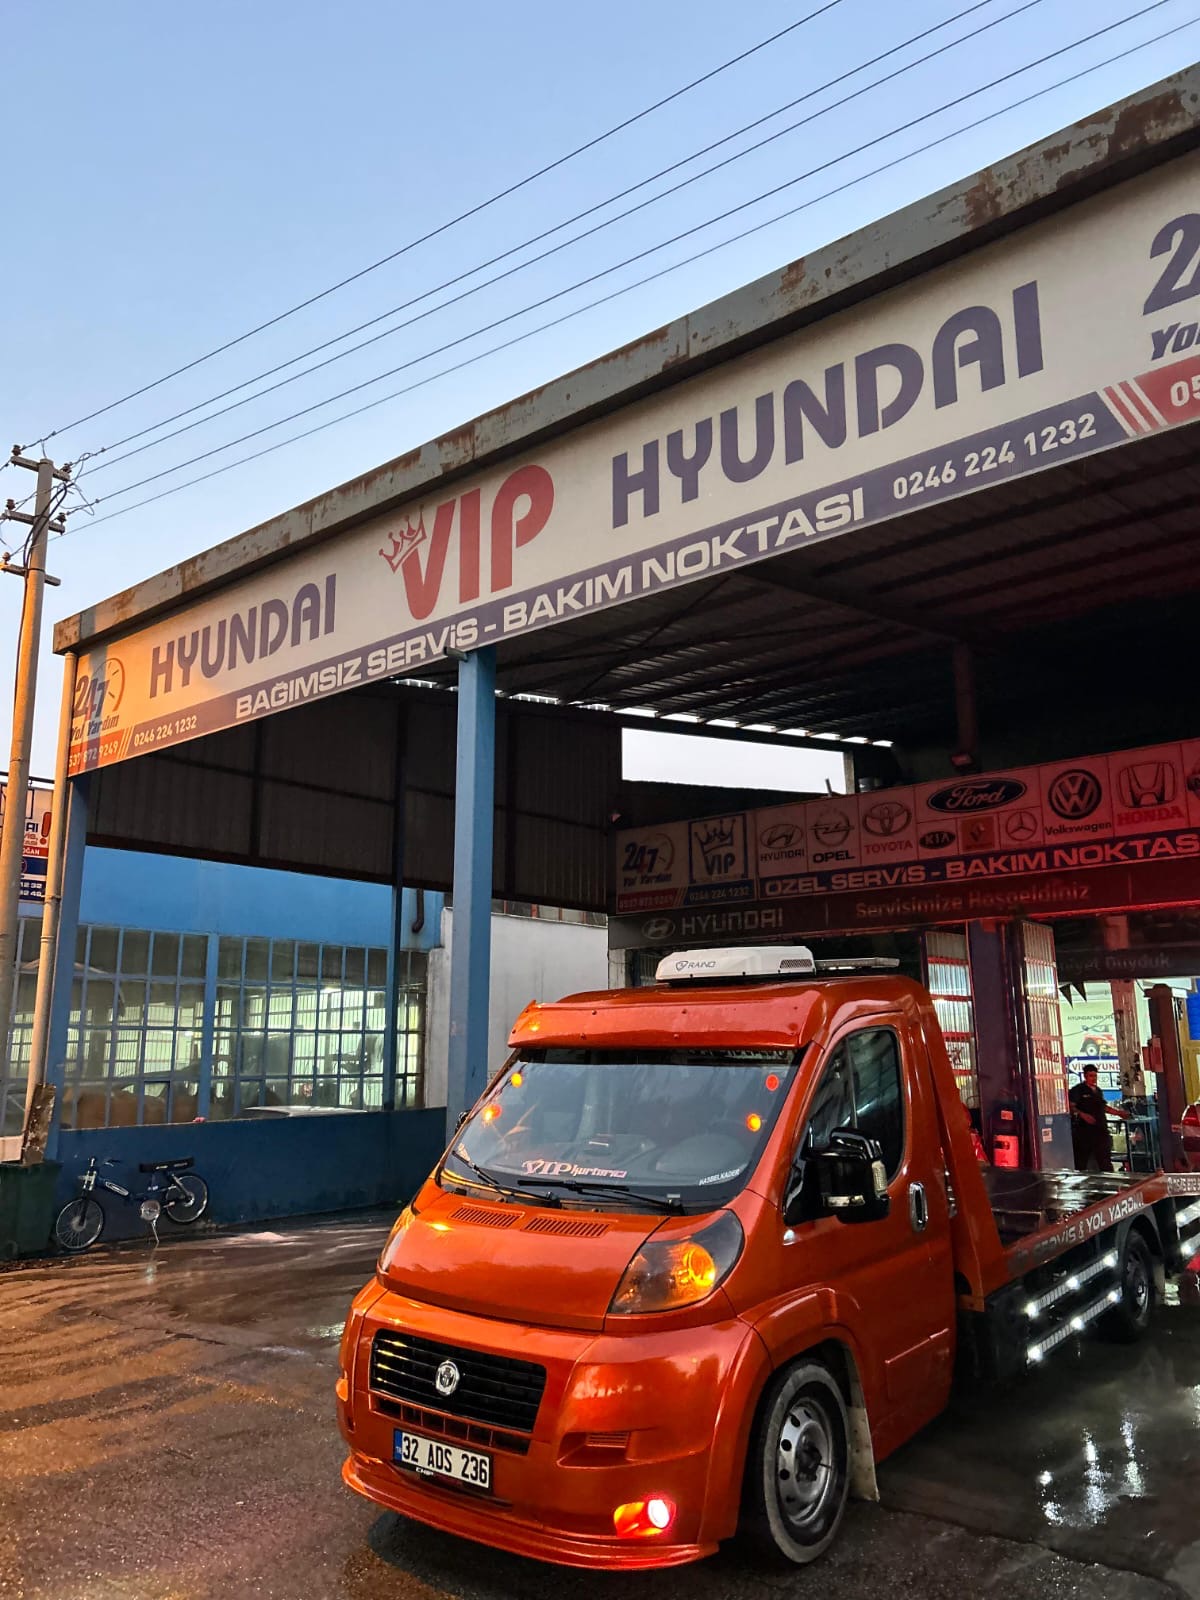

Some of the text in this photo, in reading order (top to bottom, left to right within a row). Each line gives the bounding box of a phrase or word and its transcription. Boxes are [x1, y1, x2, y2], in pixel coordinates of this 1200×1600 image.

[1143, 213, 1200, 316] 2
[1151, 322, 1200, 361] YO
[612, 280, 1044, 530] HYUNDAI
[893, 413, 1097, 500] 0246 224 1232
[399, 464, 555, 621] VIP
[235, 656, 363, 720] BAĞIMSIZ
[367, 617, 478, 677] SERVİS
[503, 565, 632, 633] BAKIM
[642, 488, 864, 589] NOKTASI
[150, 573, 337, 699] HYUNDAI
[134, 715, 198, 747] 0246 224 1232
[946, 784, 1006, 809] Ford
[1044, 821, 1113, 836] Volkswagen
[1117, 806, 1184, 825] HONDA
[864, 840, 913, 854] TOYOTA
[925, 833, 950, 845] KIA
[704, 853, 736, 876] VIP
[760, 849, 805, 862] HYUNDAI
[813, 850, 856, 863] OPEL
[832, 864, 925, 889] SERVİS
[947, 850, 1047, 880] BAKIM
[681, 907, 784, 936] HYUNDAI
[1086, 1211, 1106, 1233] YOL
[403, 1436, 488, 1484] 32 ADS 236
